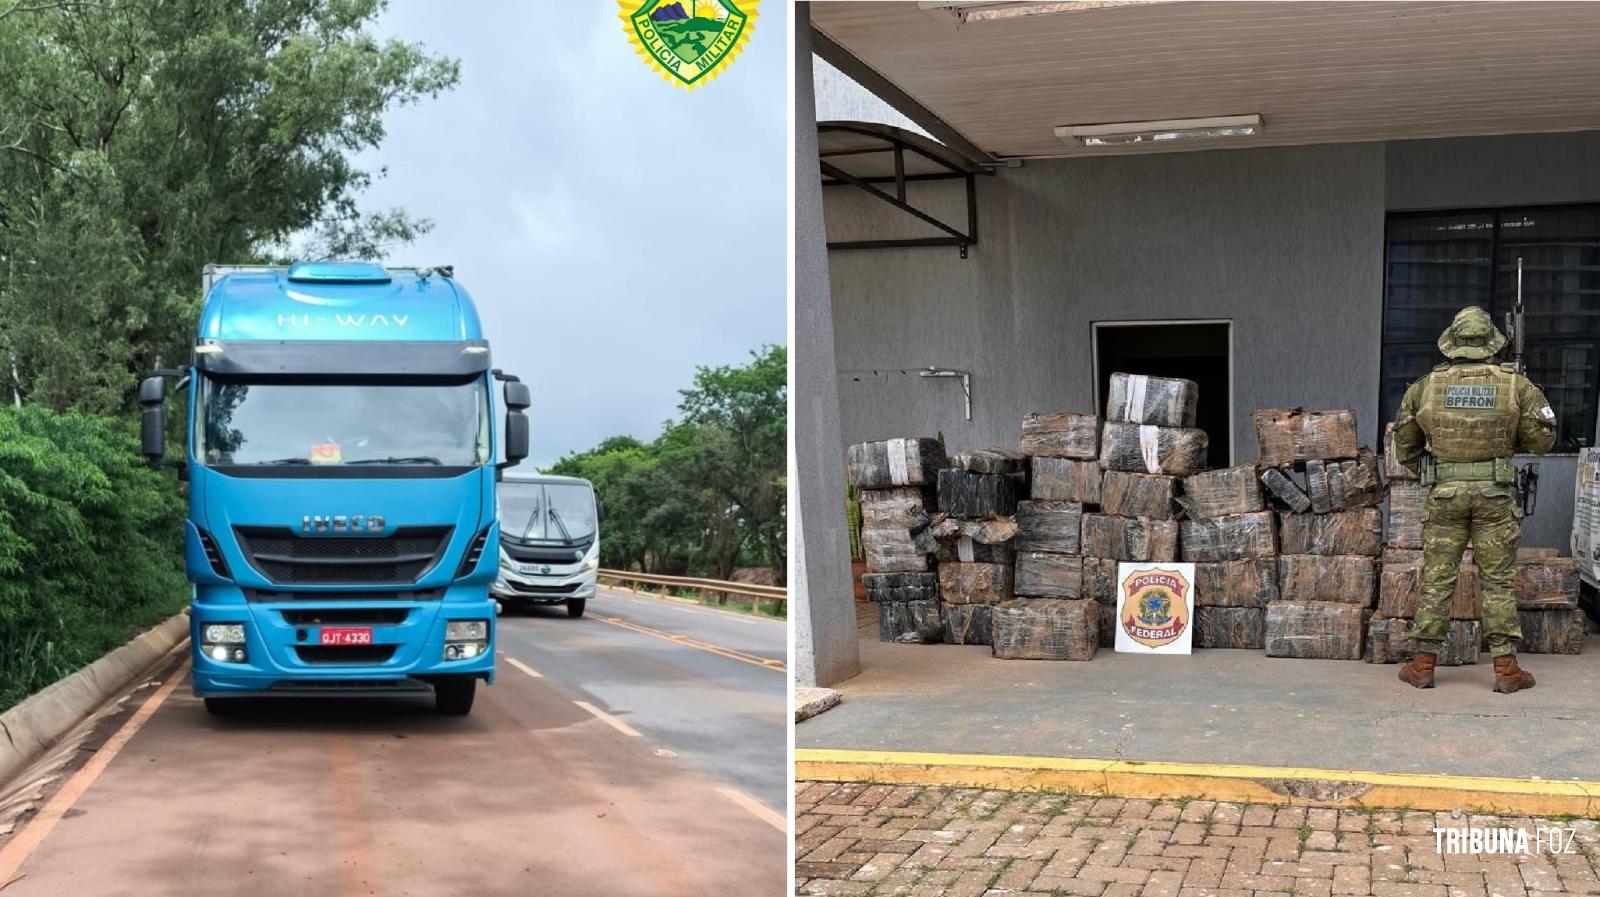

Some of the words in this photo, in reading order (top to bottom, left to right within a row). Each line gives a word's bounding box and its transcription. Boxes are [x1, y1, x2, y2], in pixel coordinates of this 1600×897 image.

[277, 313, 409, 328] HI-WAY
[1446, 396, 1494, 407] BPFRON
[303, 514, 386, 532] IVECO
[1131, 625, 1177, 639] FEDERAL
